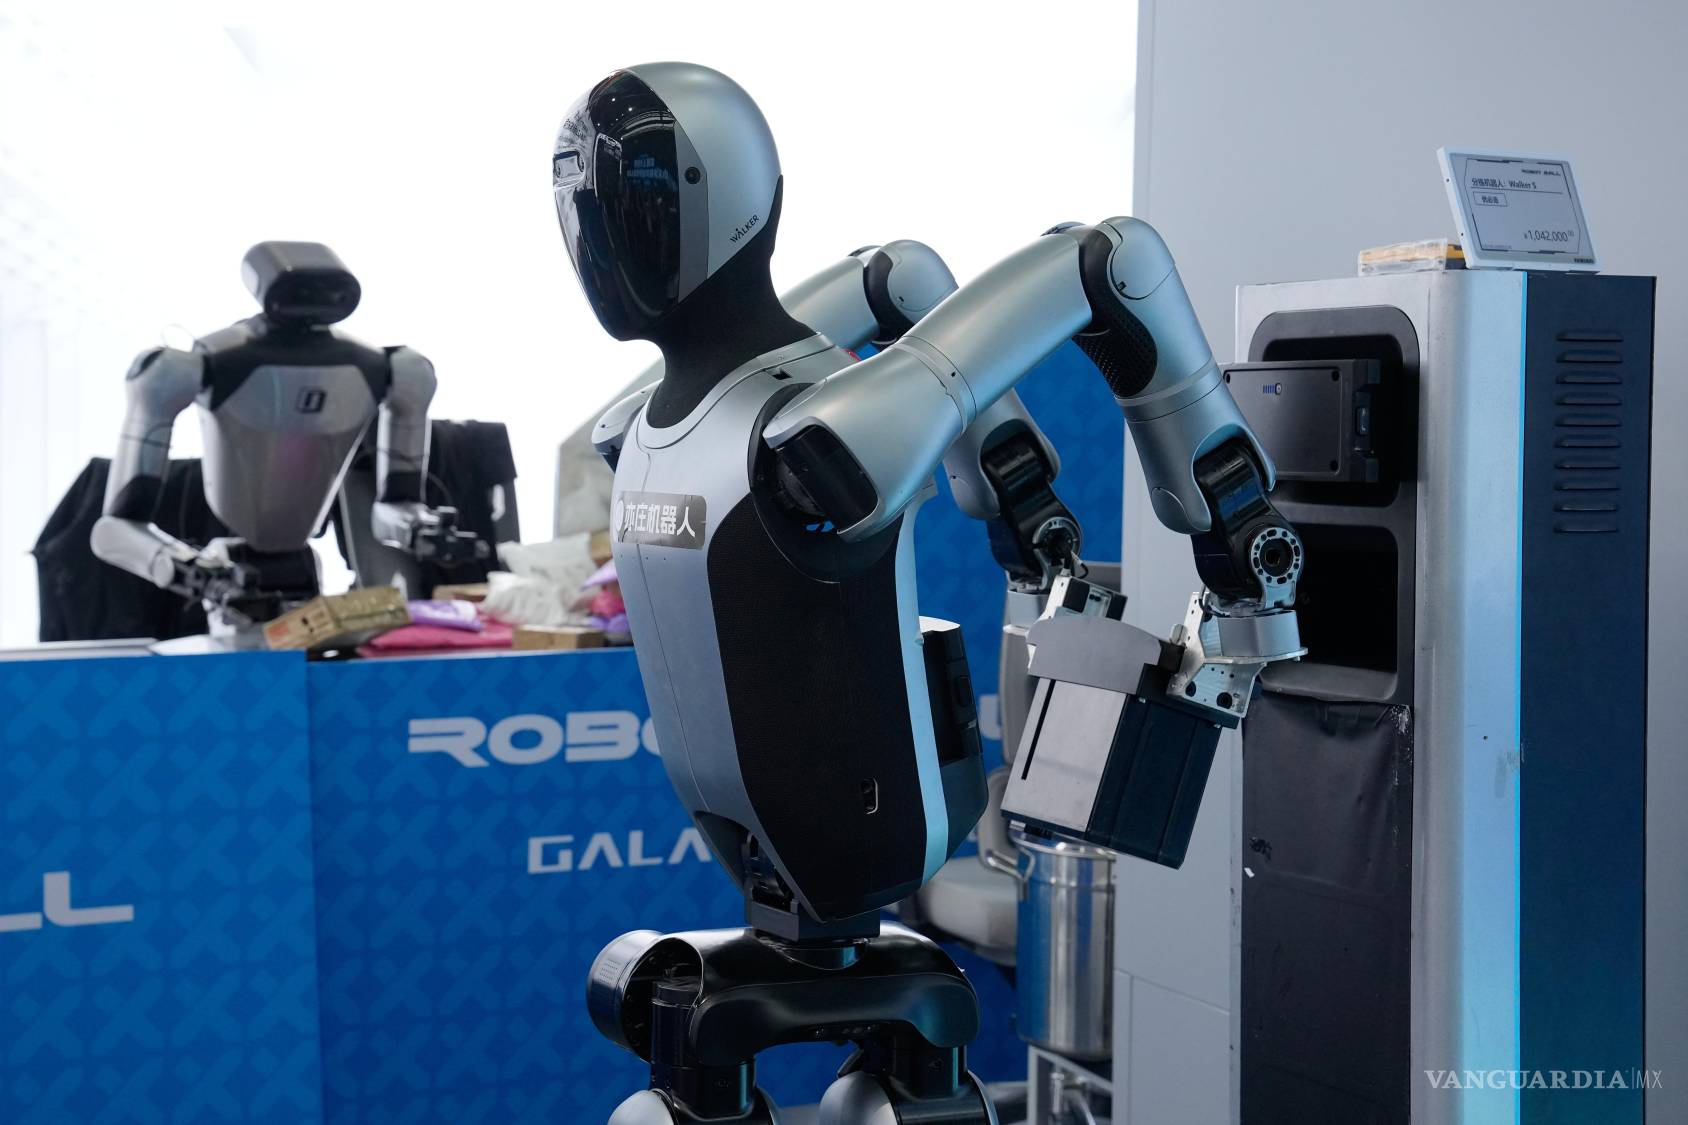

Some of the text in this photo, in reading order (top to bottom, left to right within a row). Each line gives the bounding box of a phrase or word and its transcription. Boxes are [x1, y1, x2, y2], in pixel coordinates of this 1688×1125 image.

[729, 214, 760, 243] WALKER
[624, 502, 696, 538] 亦庄机器人
